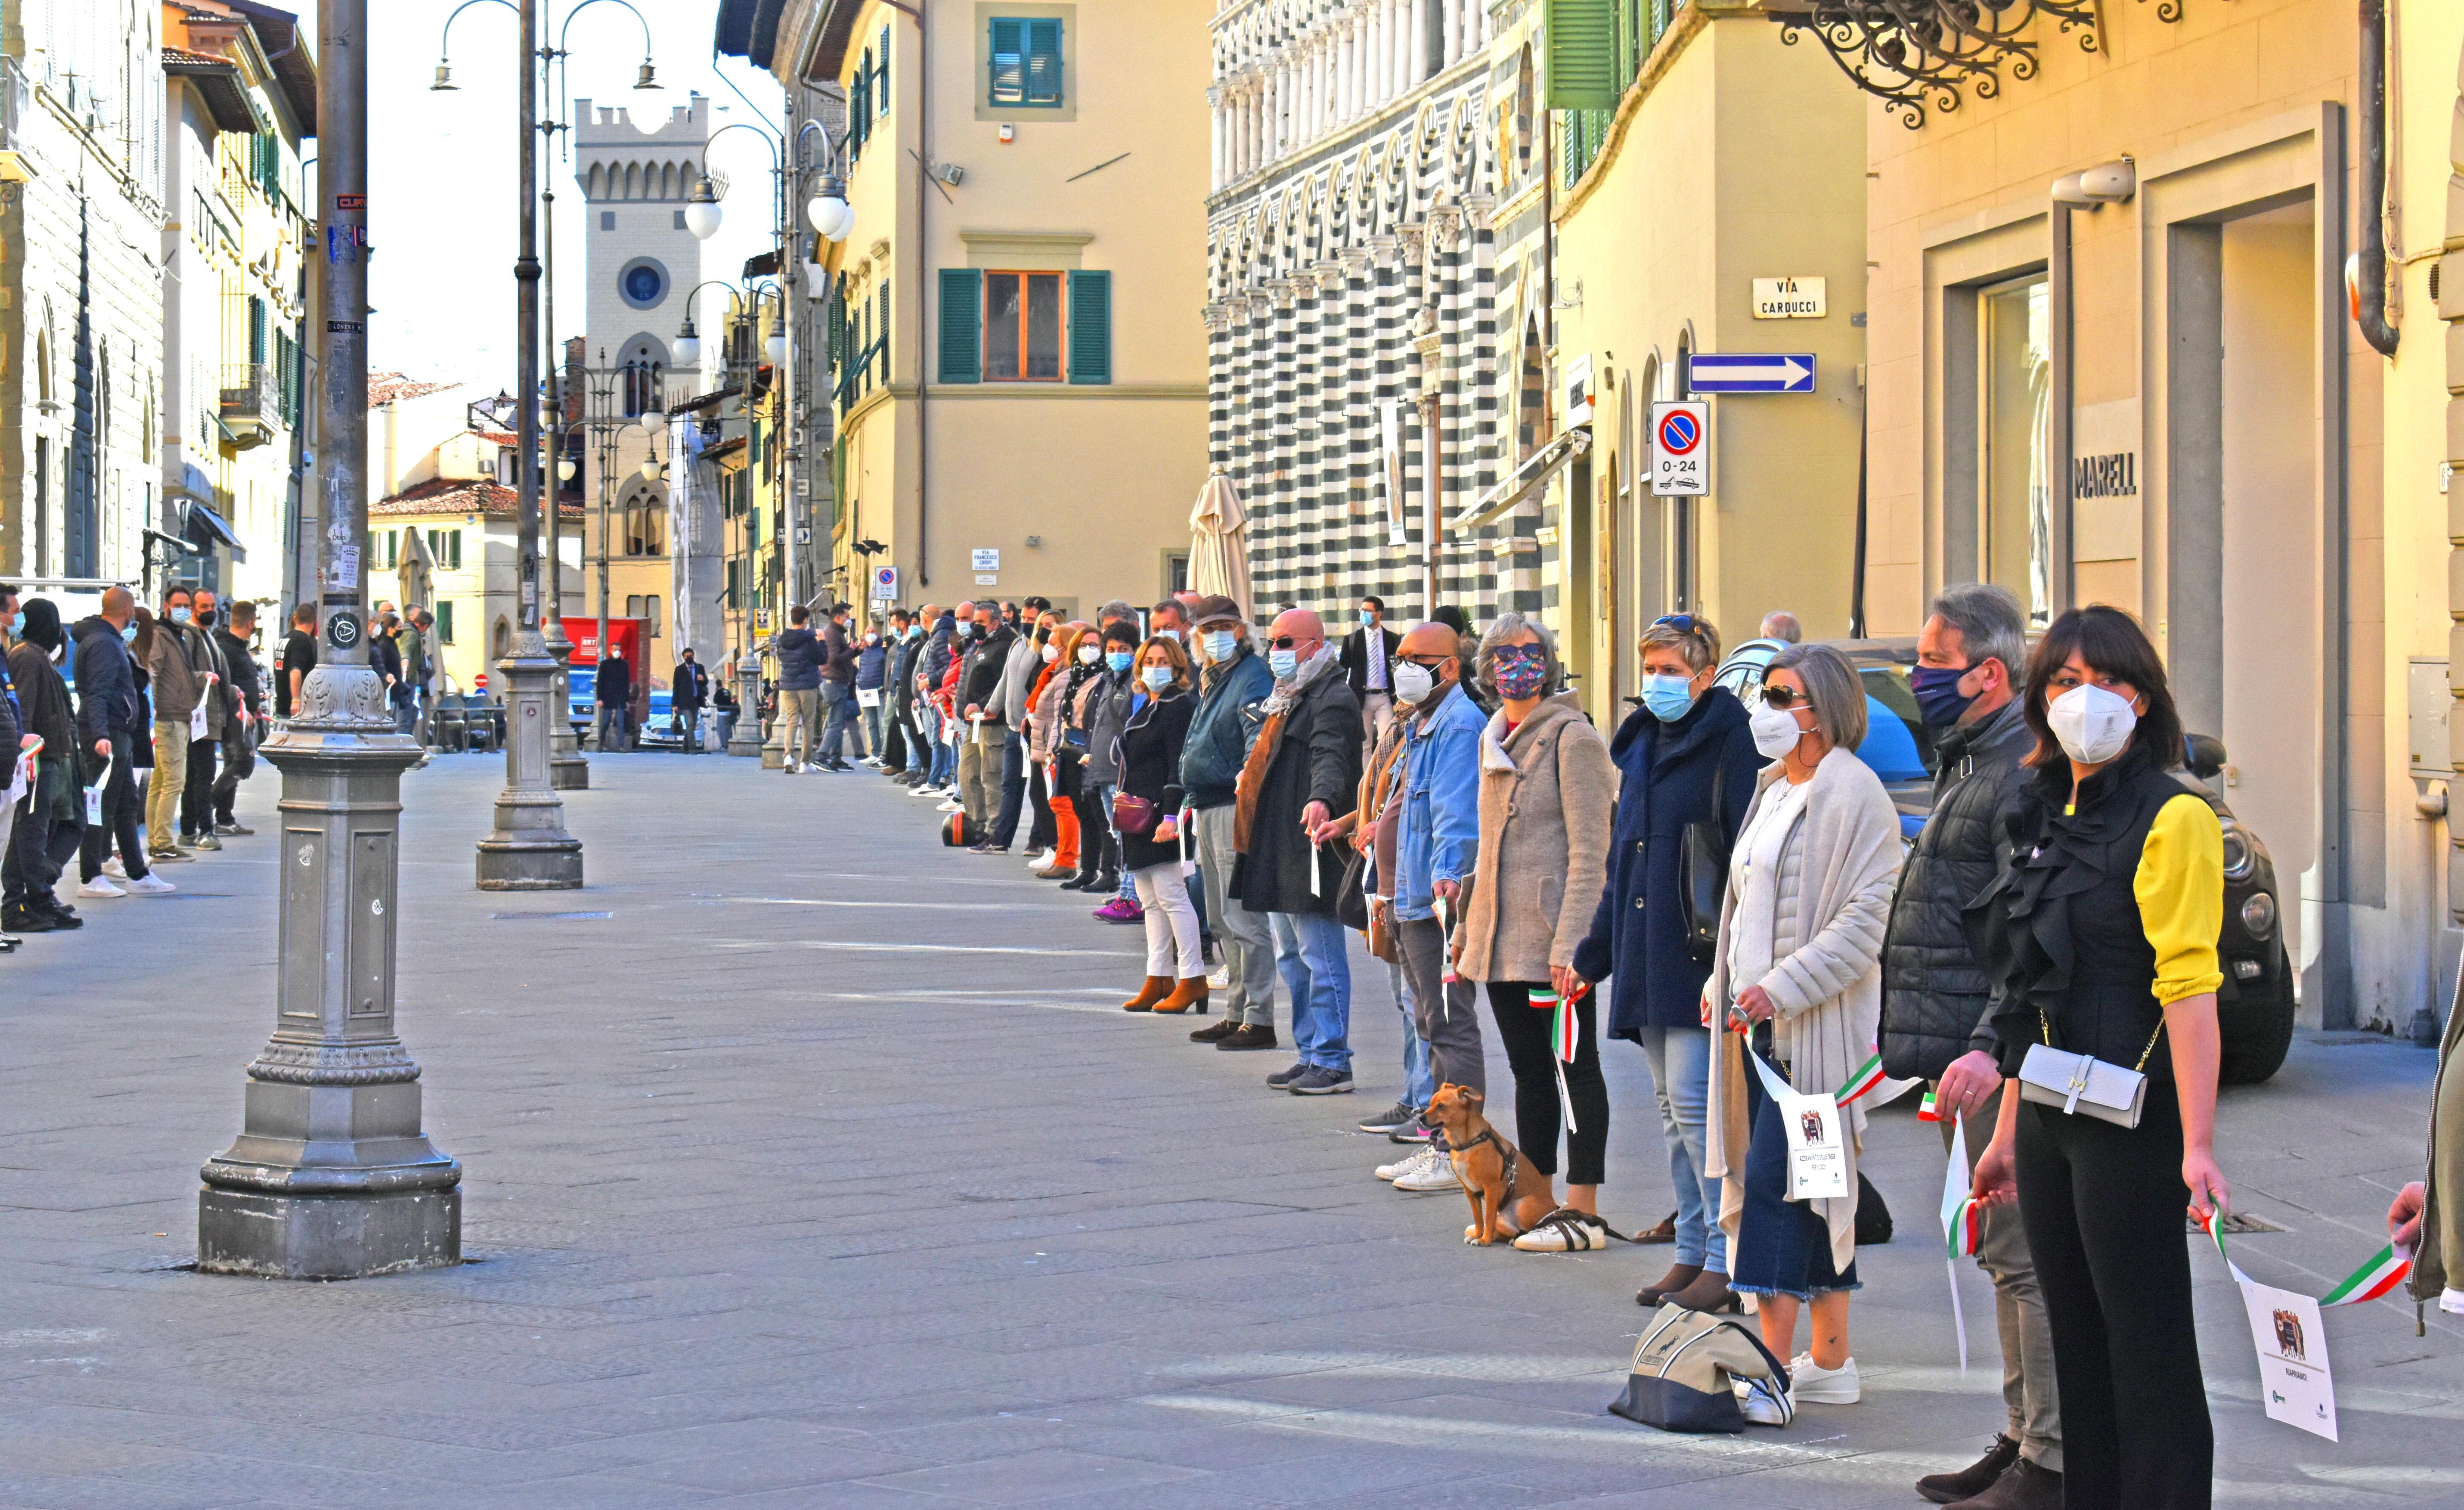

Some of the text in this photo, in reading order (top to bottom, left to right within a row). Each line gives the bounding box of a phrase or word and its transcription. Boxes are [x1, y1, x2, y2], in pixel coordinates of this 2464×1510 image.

[1777, 282, 1798, 293] VIA
[1762, 301, 1816, 313] CARDUCCI
[2074, 452, 2136, 499] MARELL
